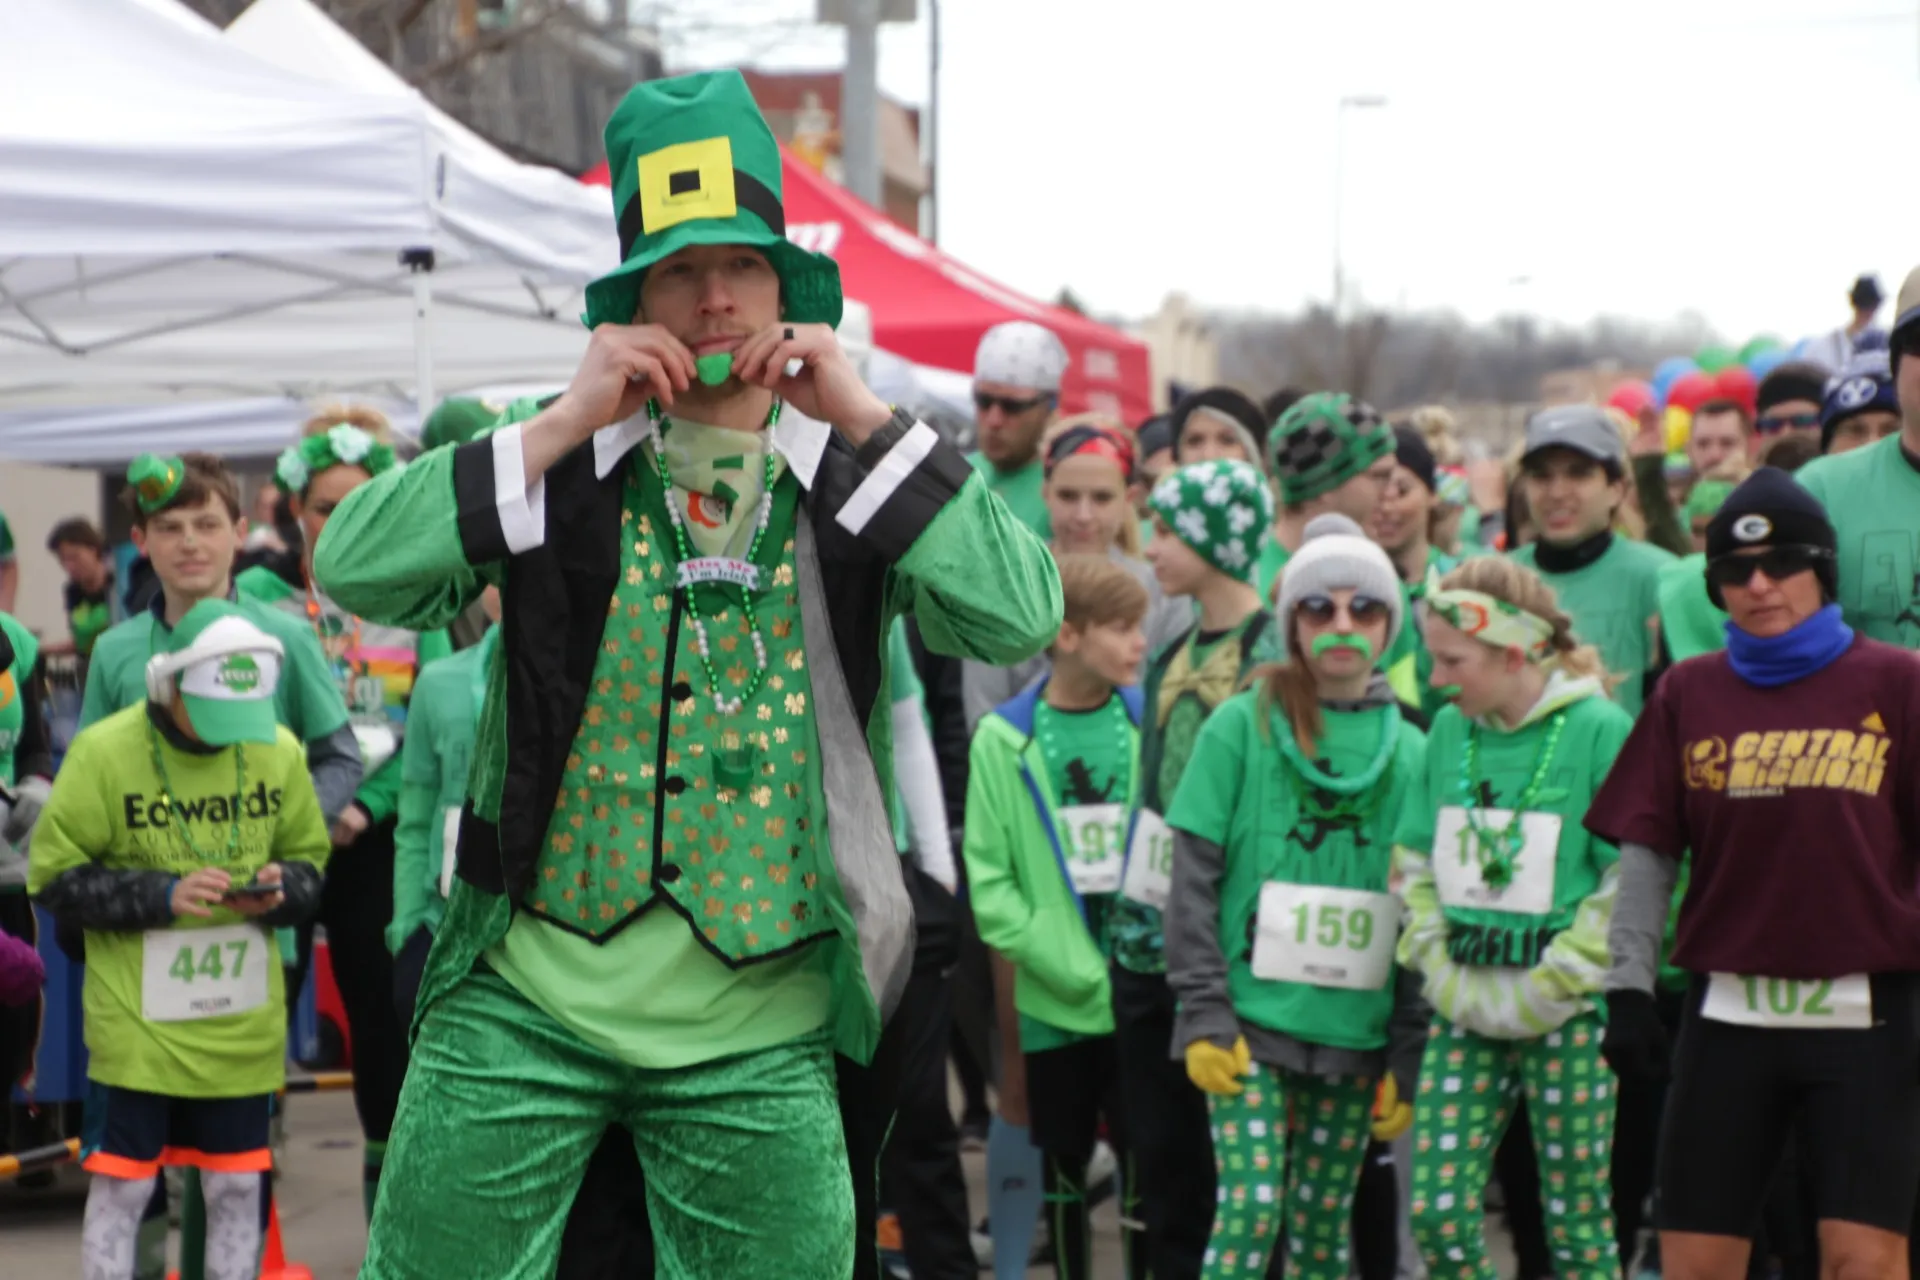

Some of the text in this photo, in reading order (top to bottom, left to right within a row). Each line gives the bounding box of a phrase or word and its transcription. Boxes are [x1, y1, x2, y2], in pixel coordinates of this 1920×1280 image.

[1731, 729, 1891, 767] CENTRAL
[124, 781, 282, 830] Edwards
[1290, 902, 1373, 951] 159
[169, 940, 248, 983] 447
[1737, 974, 1833, 1016] 102
